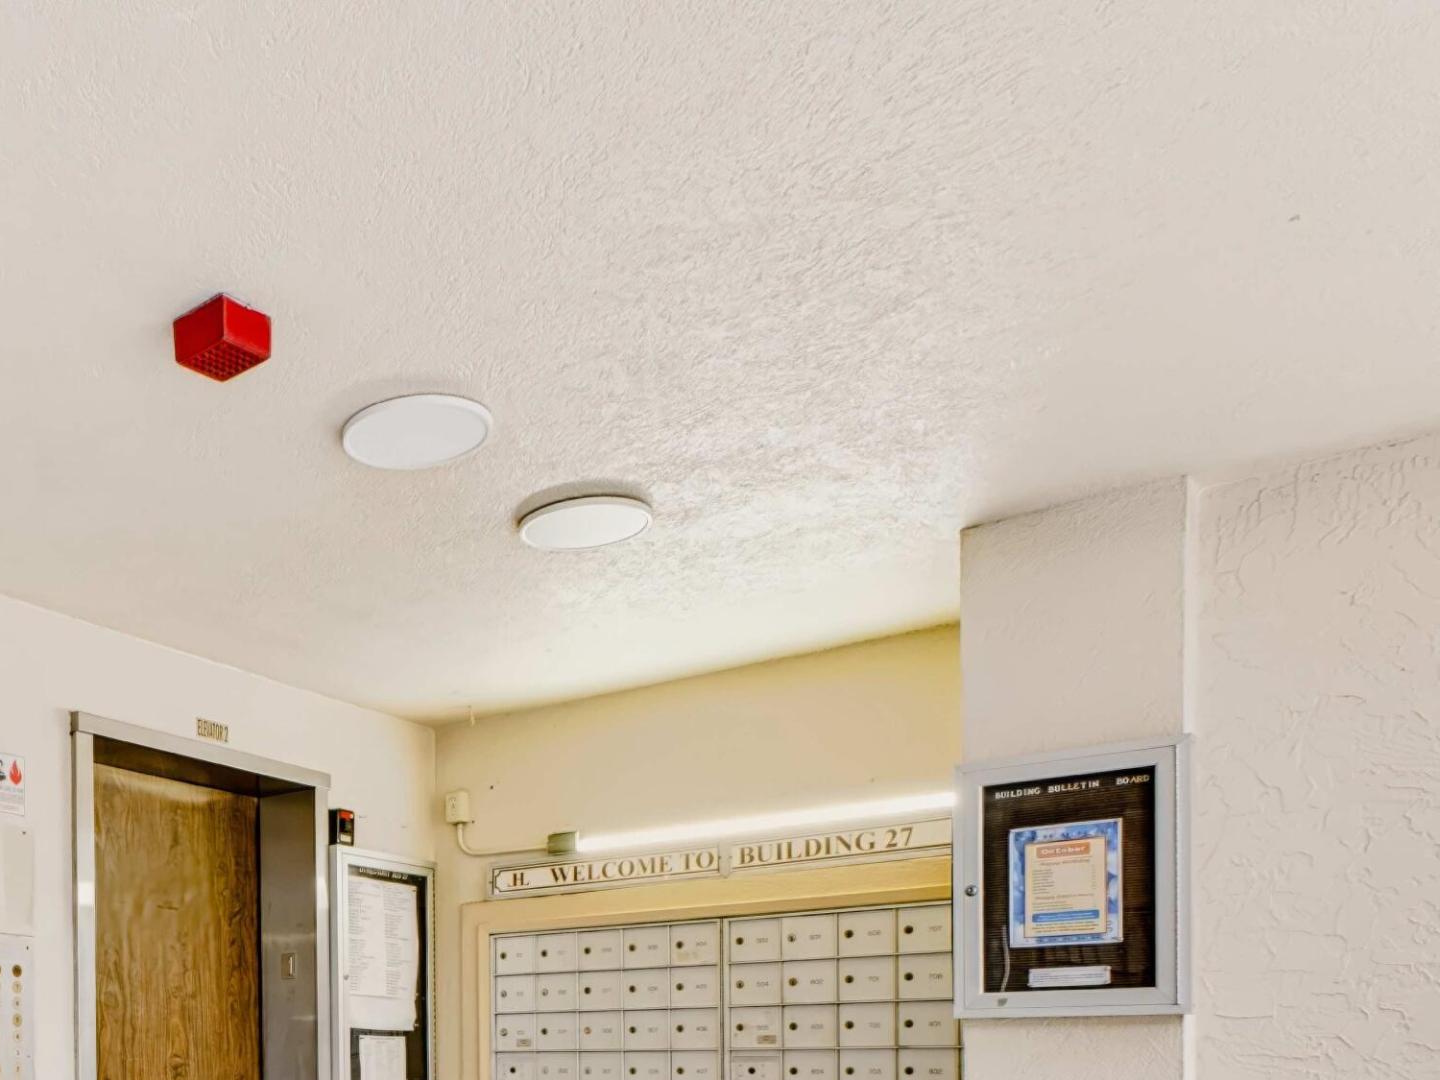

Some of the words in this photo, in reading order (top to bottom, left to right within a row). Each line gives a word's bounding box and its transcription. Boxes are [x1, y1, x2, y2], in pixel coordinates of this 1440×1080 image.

[994, 787, 1041, 799] BUILDING
[1047, 780, 1100, 793] BULLETIN
[1116, 774, 1150, 786] BOARD
[549, 854, 673, 883] WELCOME
[679, 850, 715, 871] TO
[739, 831, 876, 865] BUILDING
[885, 826, 914, 848] 27
